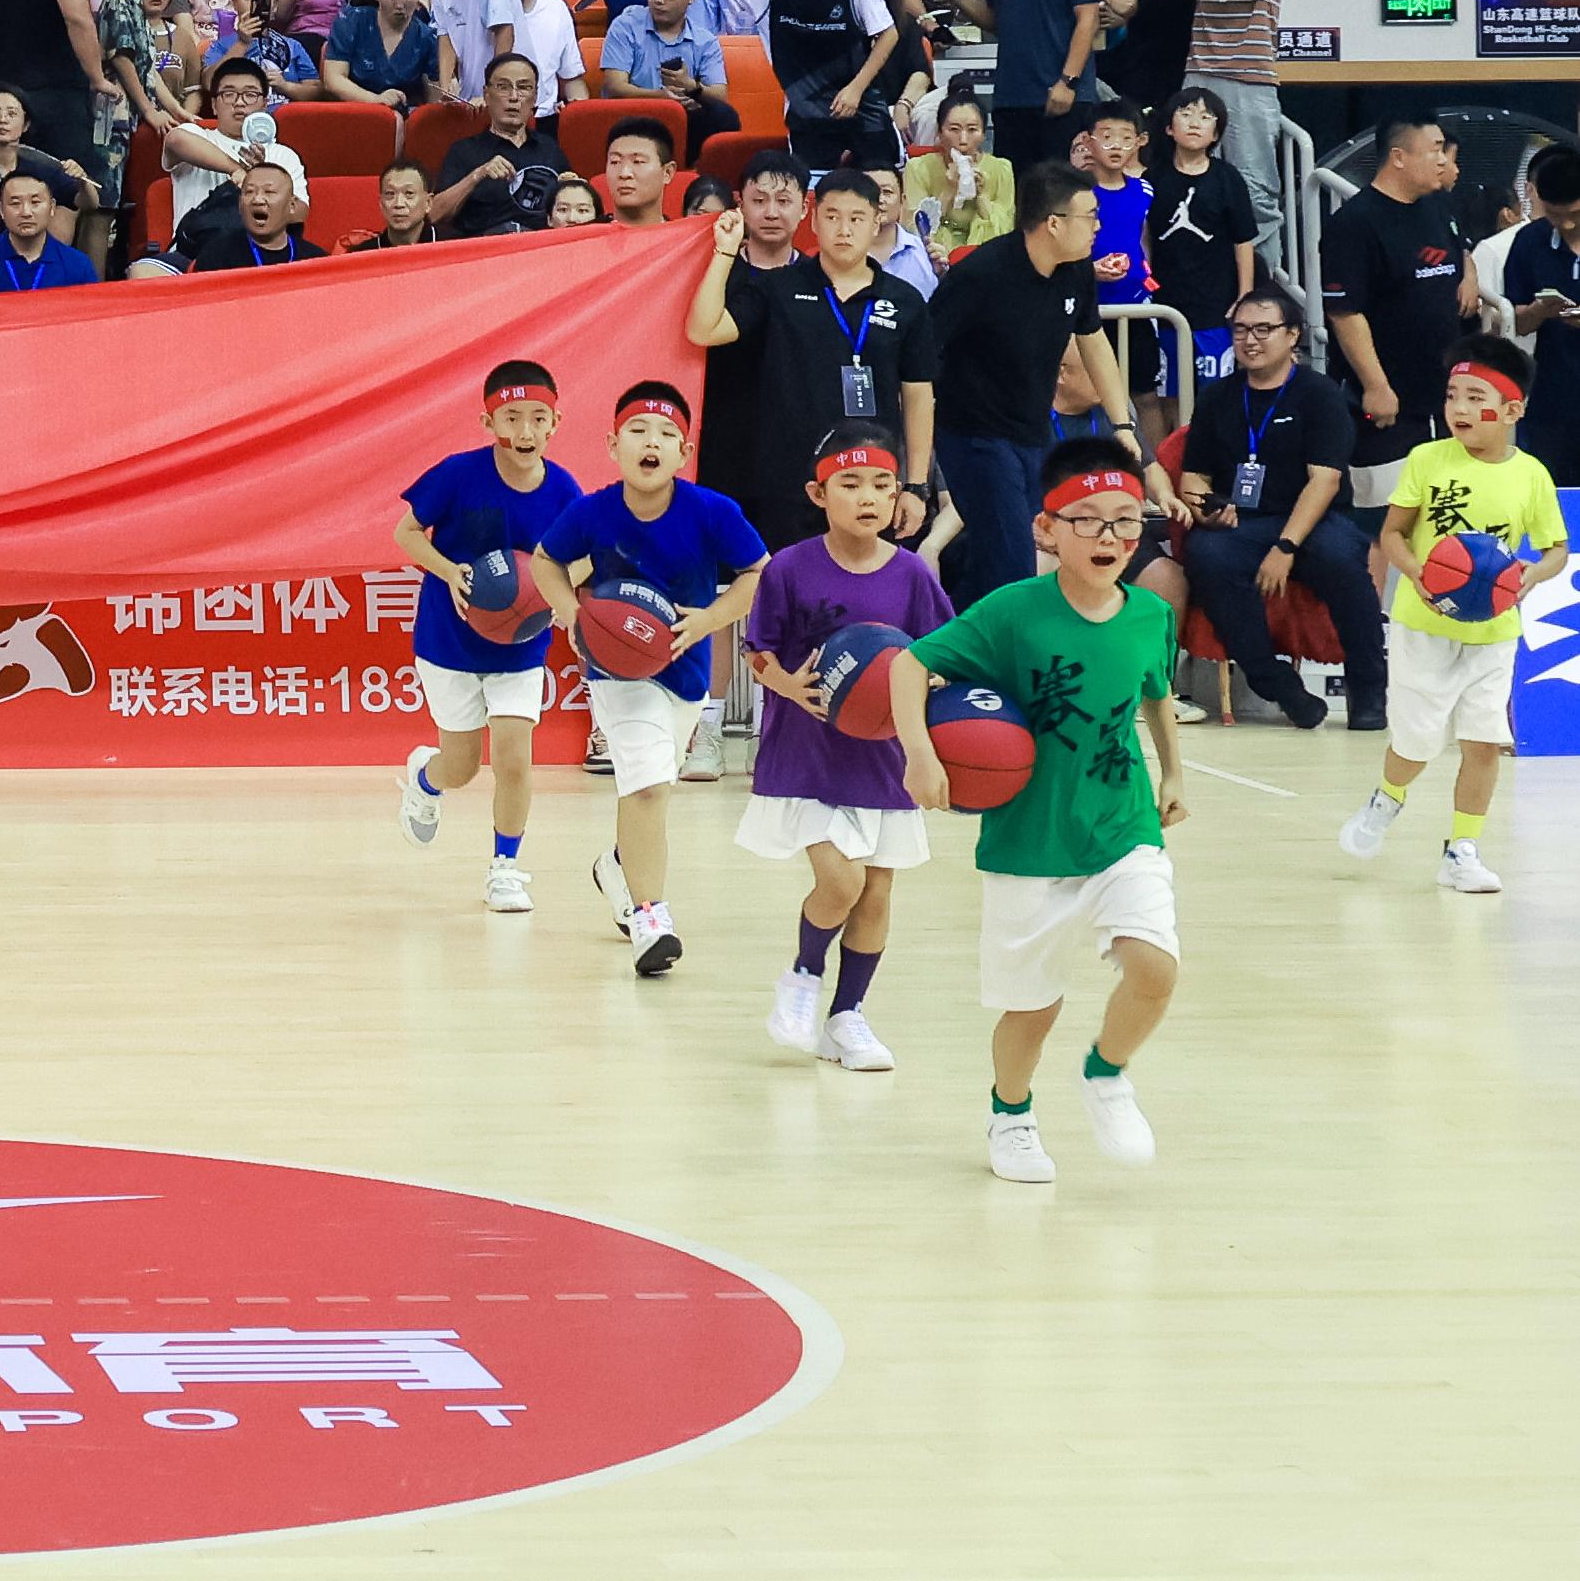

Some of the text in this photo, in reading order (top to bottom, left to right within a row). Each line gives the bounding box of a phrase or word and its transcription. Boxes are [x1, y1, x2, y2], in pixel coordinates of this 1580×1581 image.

[1547, 35, 1570, 44] Club
[500, 387, 526, 402] 中国
[645, 400, 673, 416] 中国
[836, 450, 867, 467] 中国
[1082, 472, 1123, 491] 中国
